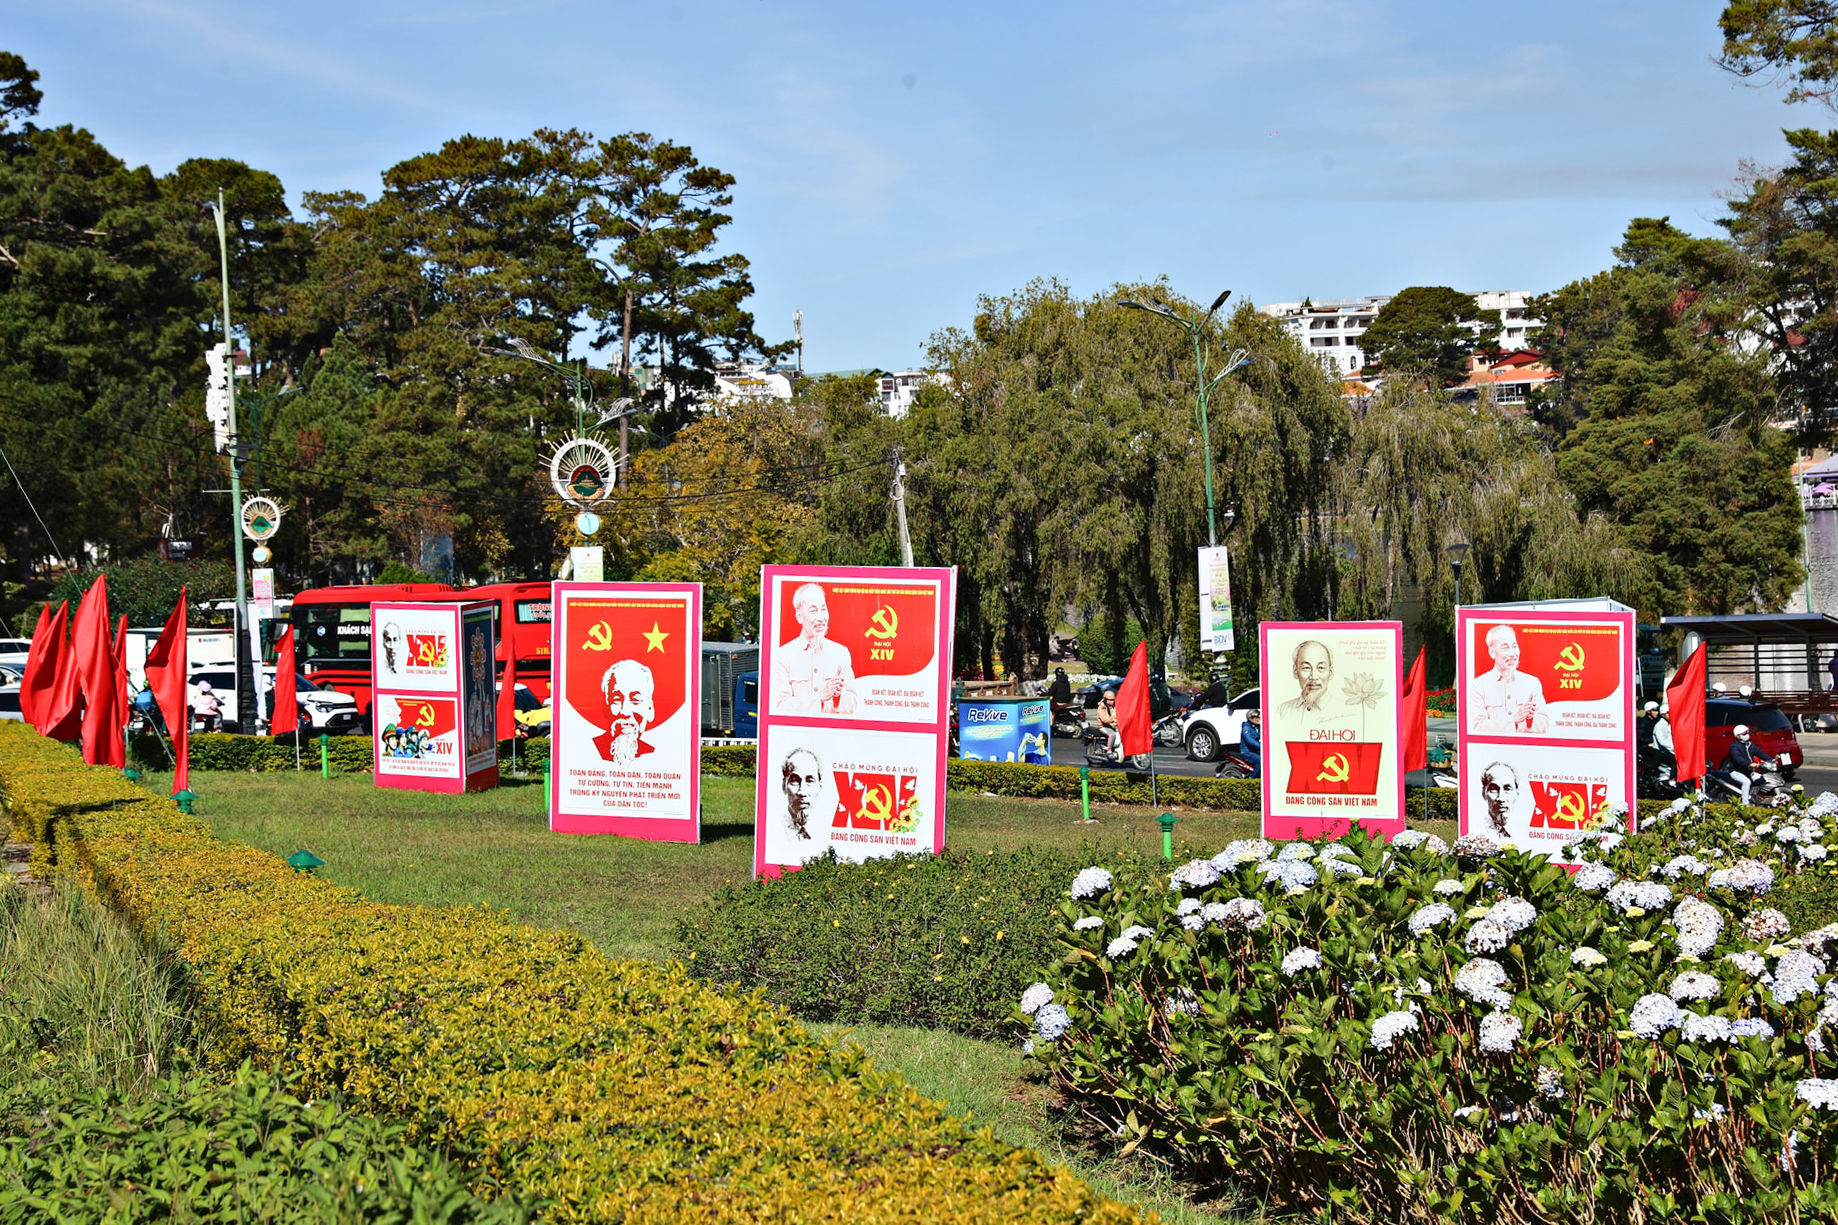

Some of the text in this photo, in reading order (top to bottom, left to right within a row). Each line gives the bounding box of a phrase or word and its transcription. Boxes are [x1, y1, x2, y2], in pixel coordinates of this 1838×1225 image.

[337, 624, 360, 634] KHÁCH
[870, 648, 894, 660] XIV
[1560, 679, 1582, 689] XIV
[436, 742, 453, 754] XIV
[1362, 798, 1377, 806] NAM
[900, 838, 916, 846] NAM
